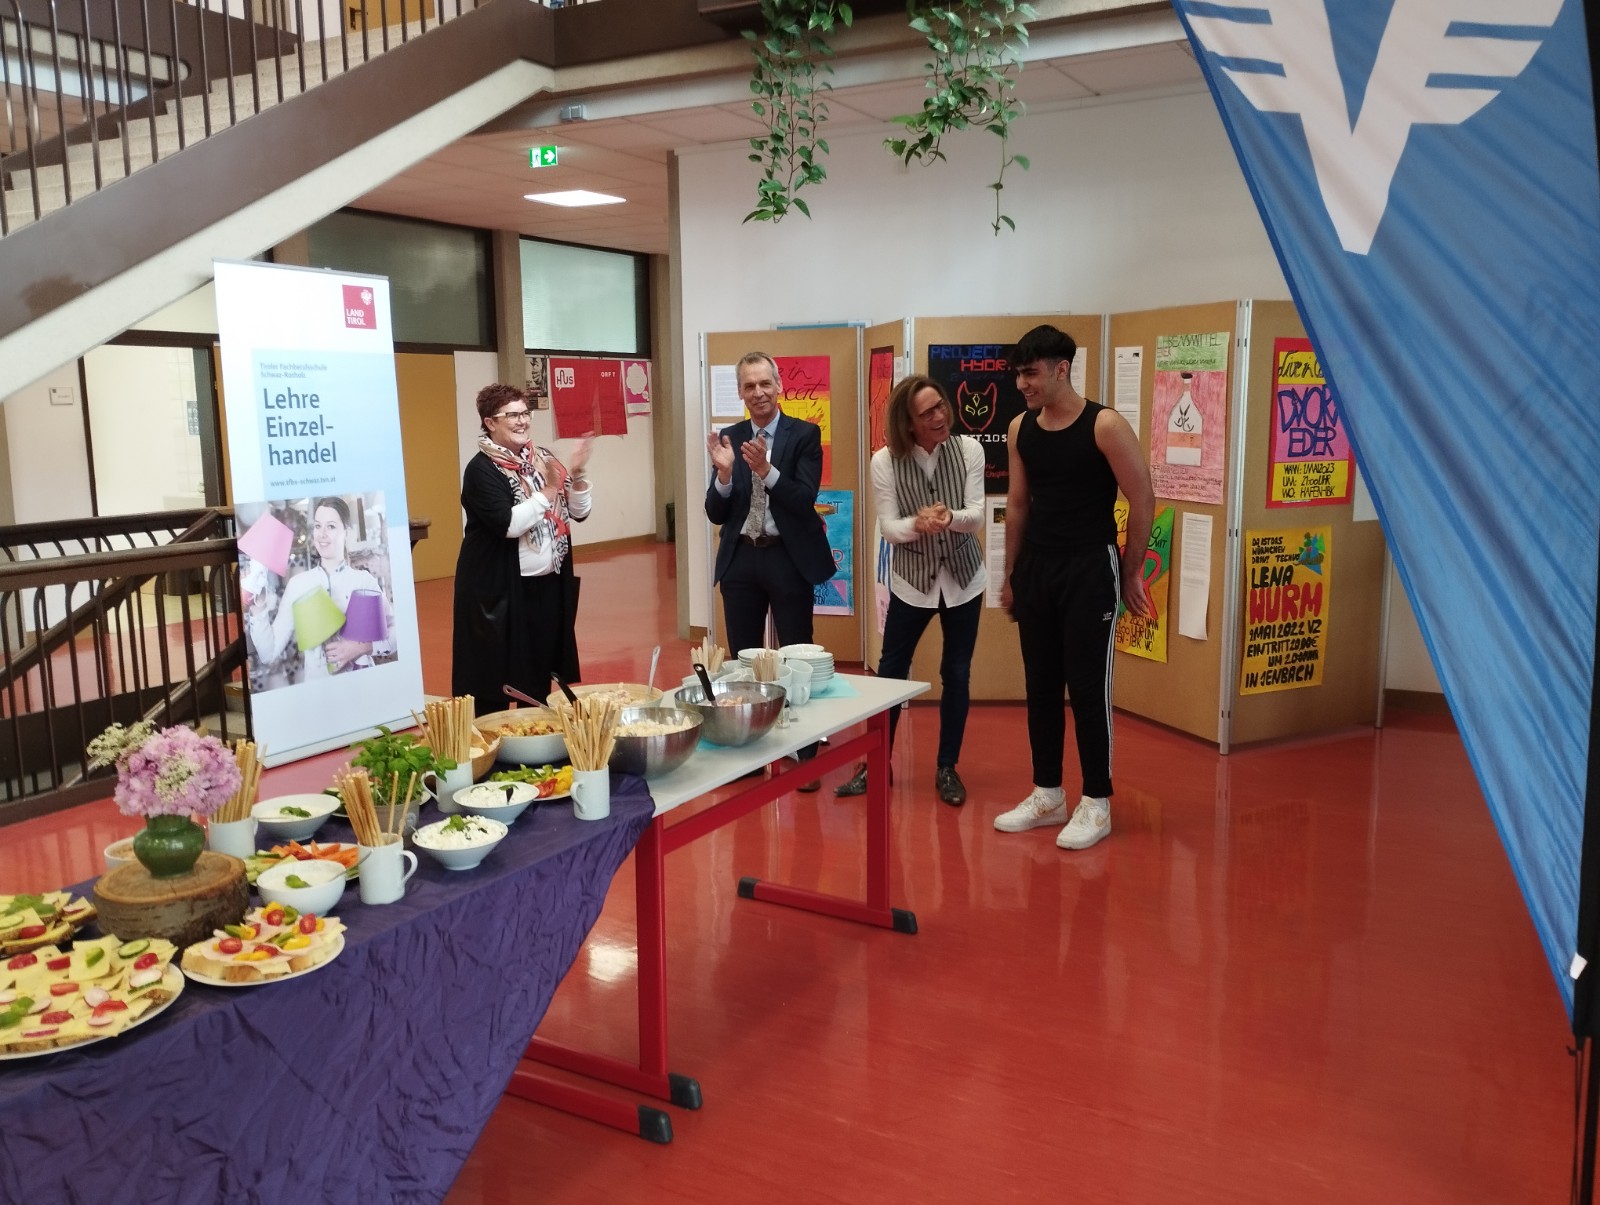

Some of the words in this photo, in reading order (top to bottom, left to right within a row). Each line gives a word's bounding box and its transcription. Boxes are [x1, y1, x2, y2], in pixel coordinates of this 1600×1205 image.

[346, 309, 365, 317] LAND
[347, 317, 367, 326] TIROL
[931, 345, 1003, 359] PROJECT
[788, 361, 812, 381] in
[961, 359, 1011, 371] HYDR
[556, 369, 574, 385] HAUS
[263, 387, 320, 409] Lehre
[266, 414, 334, 438] Einzel-
[268, 441, 337, 466] handel
[1252, 565, 1294, 588] LENA
[1250, 582, 1323, 625] WURM
[1268, 655, 1282, 667] UM
[1245, 672, 1258, 688] IN
[1261, 663, 1315, 686] JENBACH
